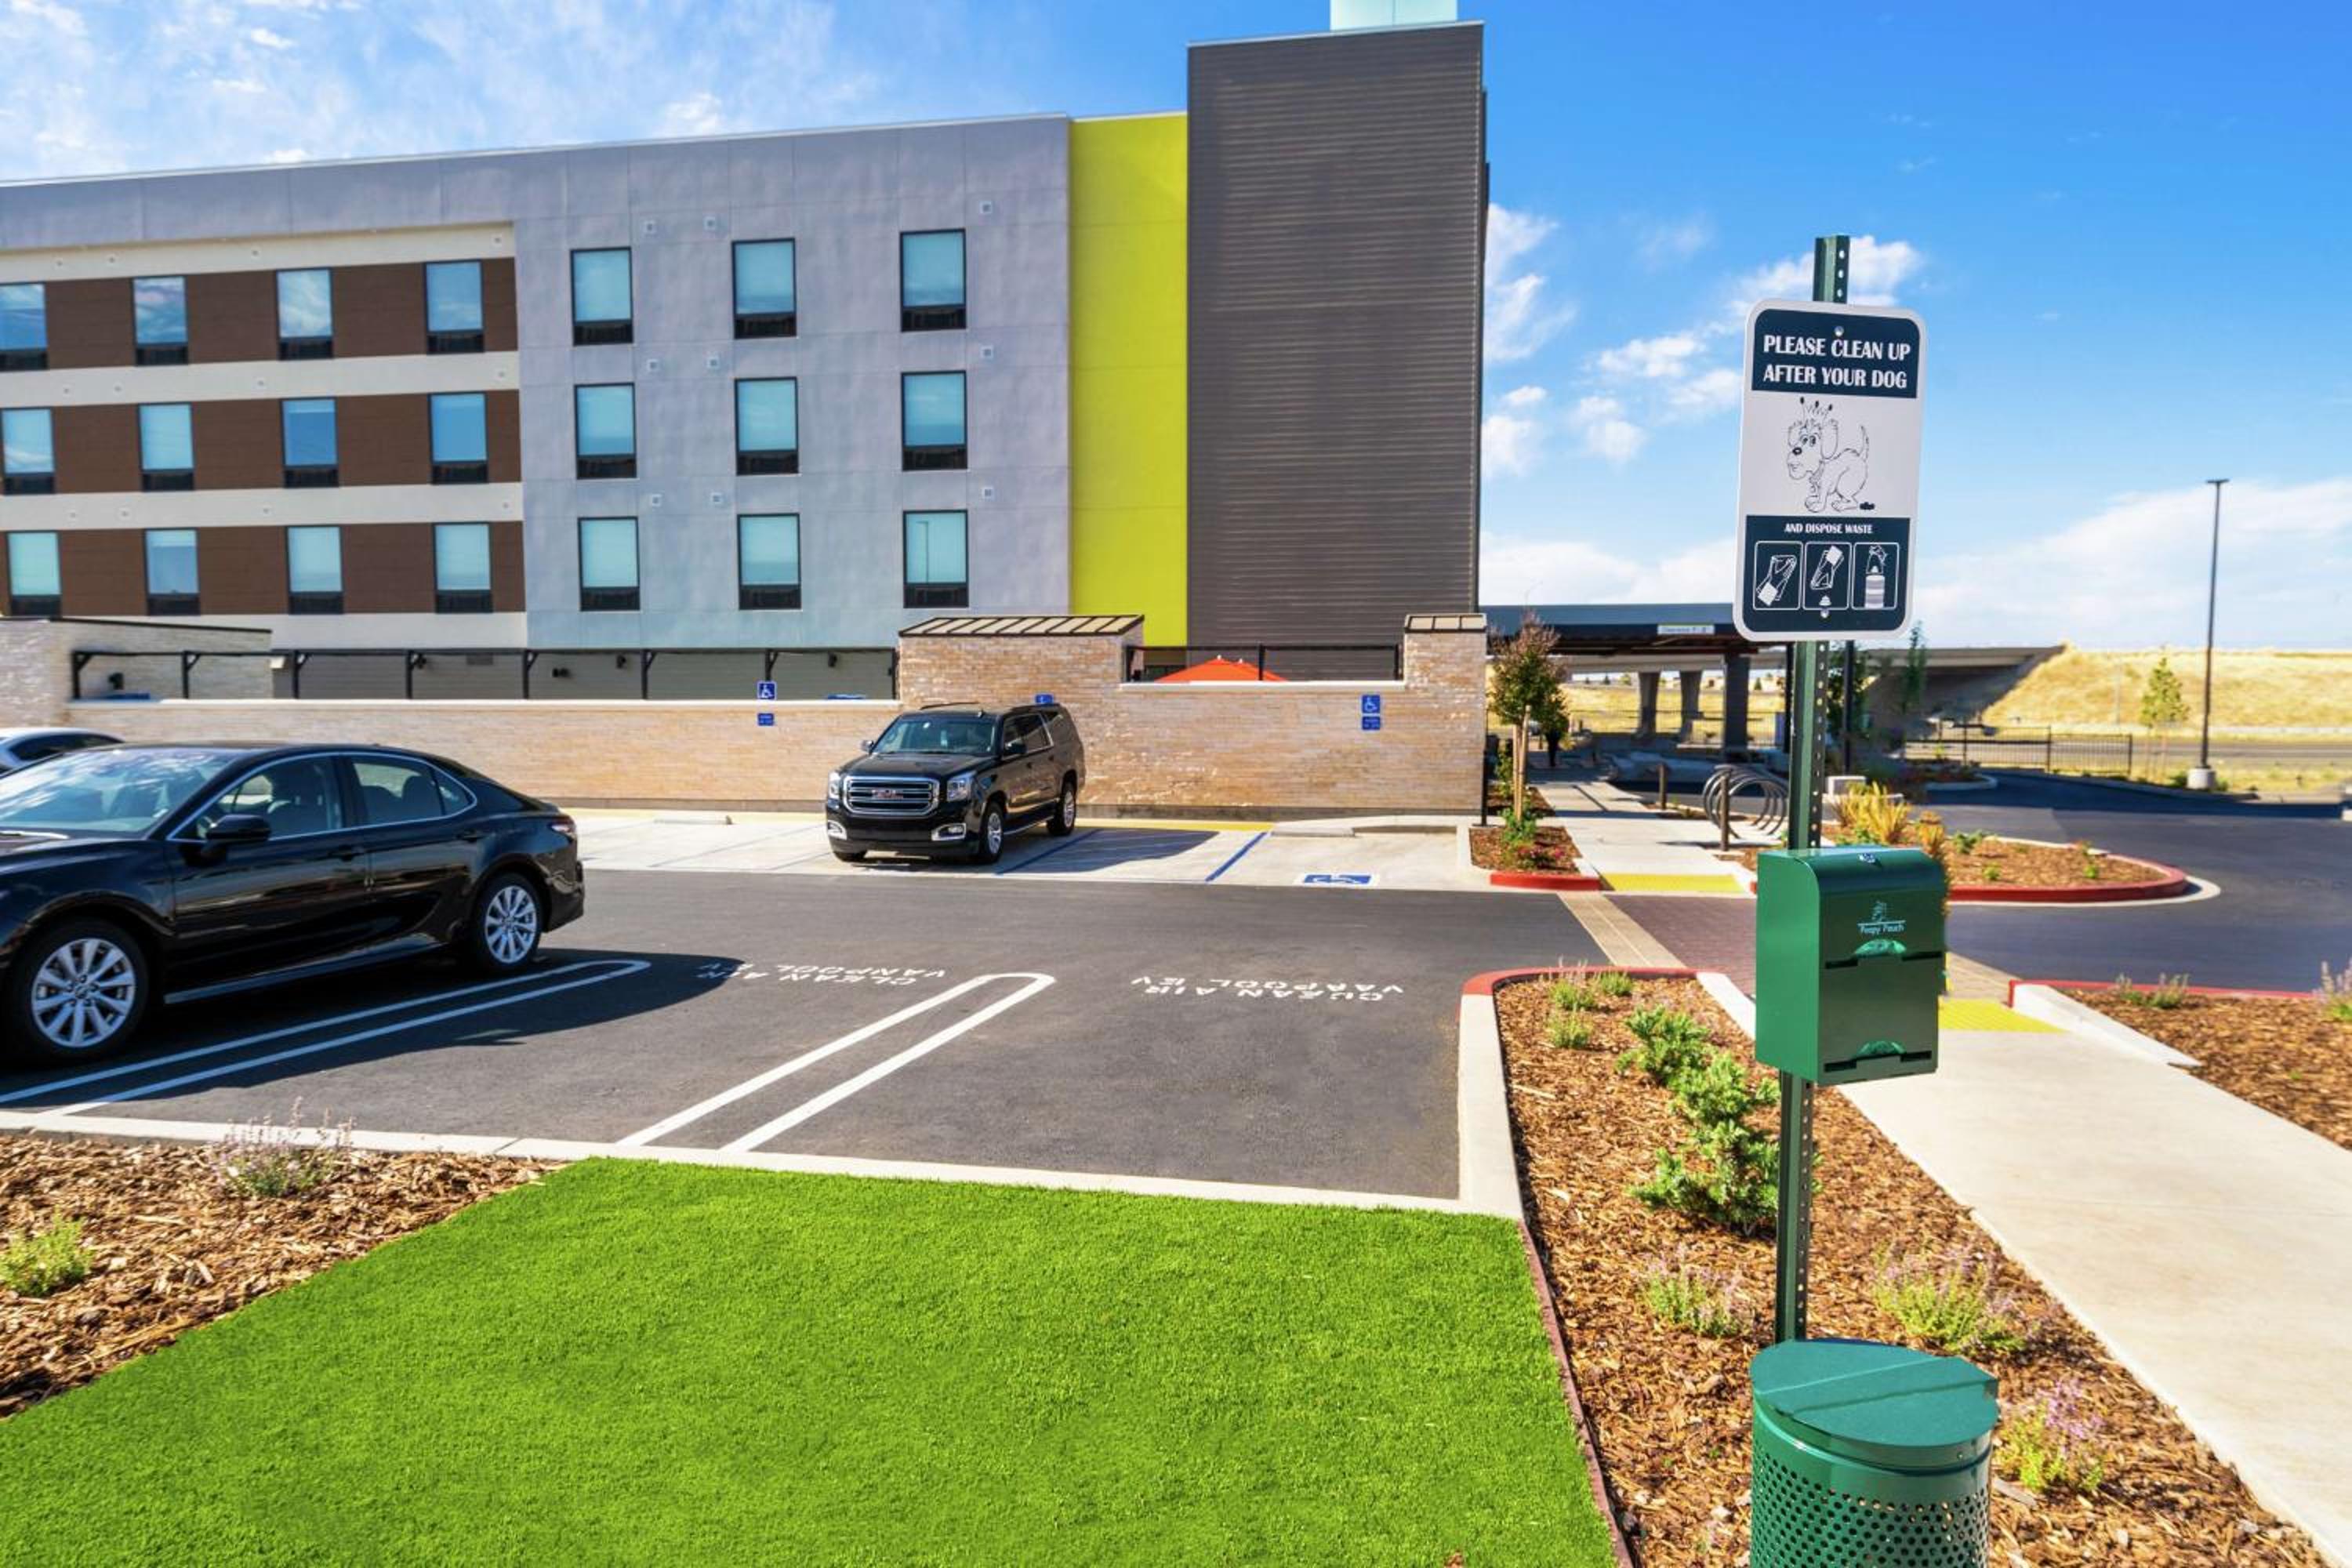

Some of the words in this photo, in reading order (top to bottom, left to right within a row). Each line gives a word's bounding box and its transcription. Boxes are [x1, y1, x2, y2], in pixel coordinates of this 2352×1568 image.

[1763, 335, 1826, 356] PLEASE
[1831, 339, 1883, 360] CLEAN
[1888, 343, 1911, 361] UP
[1763, 364, 1816, 384] AFTER
[1821, 367, 1867, 387] YOUR
[1871, 370, 1907, 389] DOG
[1784, 523, 1803, 533] AND
[1806, 523, 1843, 534] DISPOSE
[1845, 524, 1873, 534] WASTE
[778, 973, 916, 985] CLEAN
[1142, 985, 1218, 996] AIR
[1236, 988, 1384, 1001] CLEAN
